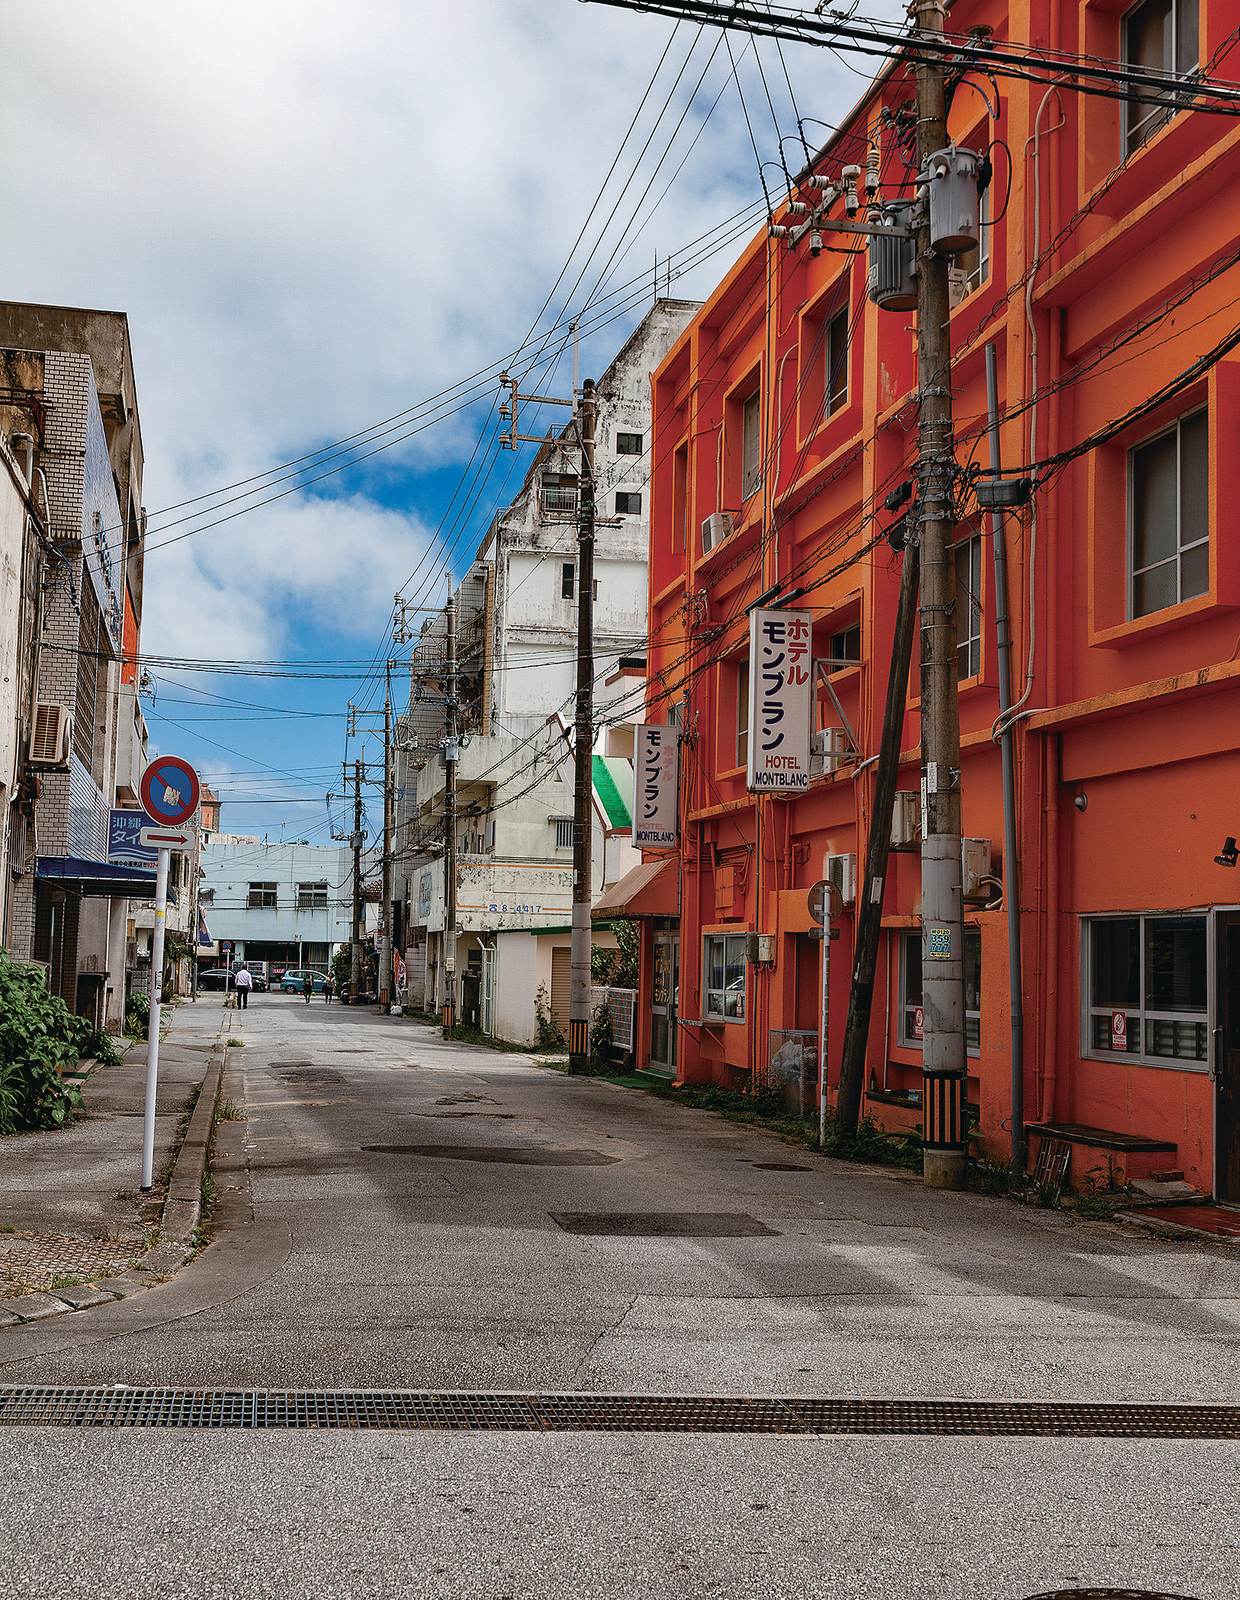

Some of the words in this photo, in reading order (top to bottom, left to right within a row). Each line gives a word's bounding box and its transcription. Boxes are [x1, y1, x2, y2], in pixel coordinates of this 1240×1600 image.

[787, 618, 809, 685] ホテル
[761, 621, 785, 751] モンブラン
[663, 745, 674, 781] ホテル
[765, 755, 801, 769] HOTEL
[644, 730, 662, 818] モンブラン
[755, 771, 808, 786] MONTBLANC
[112, 816, 141, 829] 沖縄
[638, 823, 666, 831] HOTEL
[111, 830, 141, 845] タイ
[636, 831, 675, 842] MONTBLANC
[932, 934, 949, 943] 359
[931, 943, 949, 951] 777
